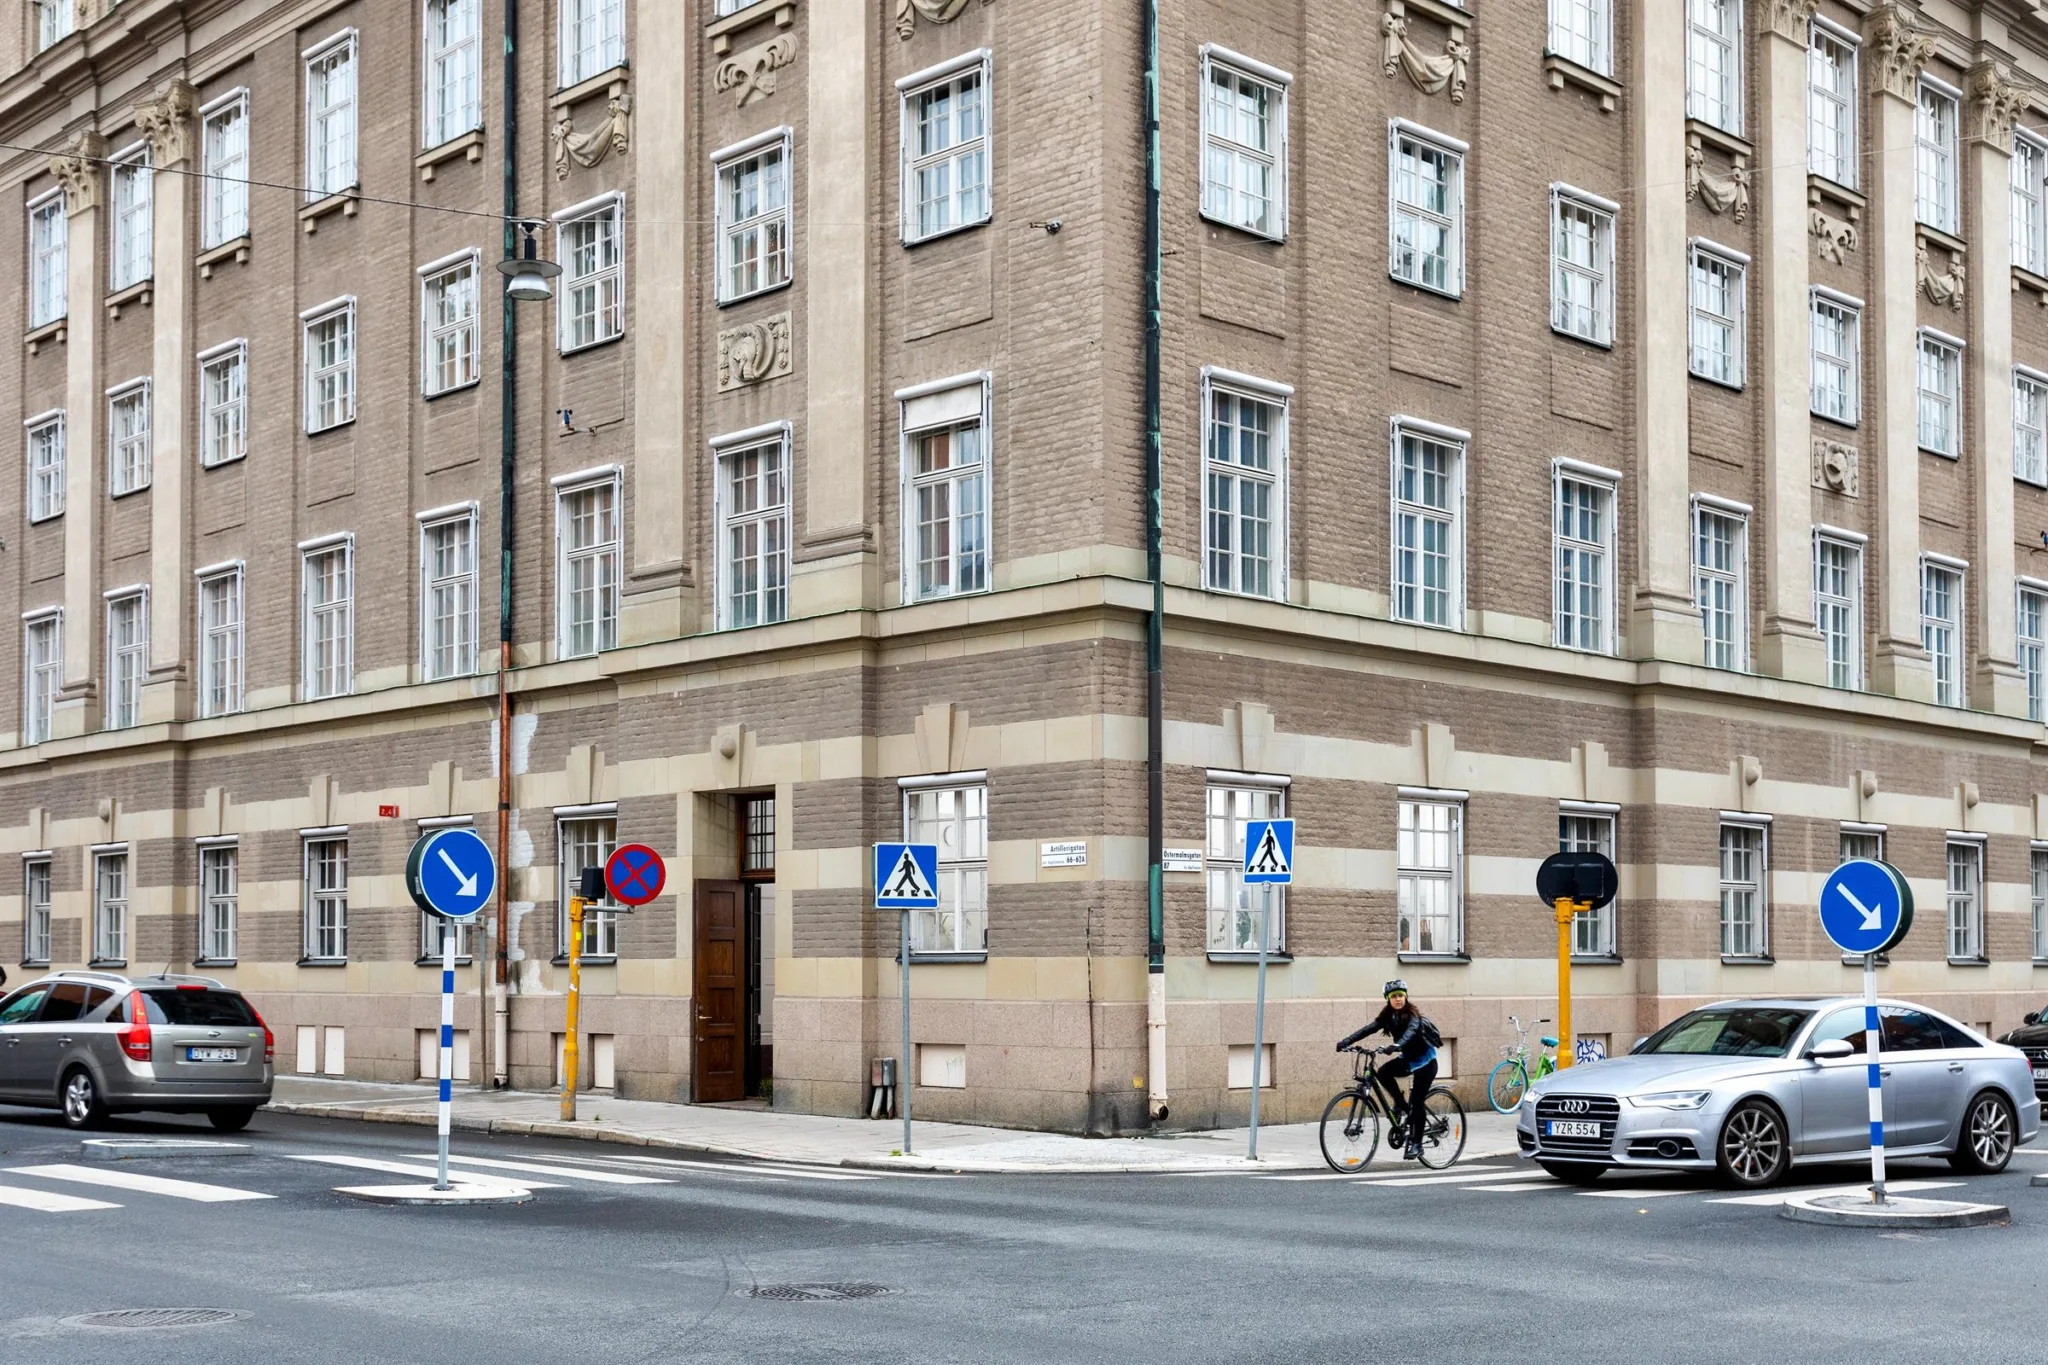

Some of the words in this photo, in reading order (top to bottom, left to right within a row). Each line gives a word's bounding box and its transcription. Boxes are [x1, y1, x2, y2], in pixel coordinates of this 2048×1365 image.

[1050, 845, 1085, 853] Artillerigatan
[1164, 850, 1201, 859] Östermalmsgatan
[218, 1048, 235, 1058] 248
[2036, 1069, 2048, 1078] GJ
[1555, 1123, 1573, 1135] YZR
[1576, 1123, 1596, 1136] 554
